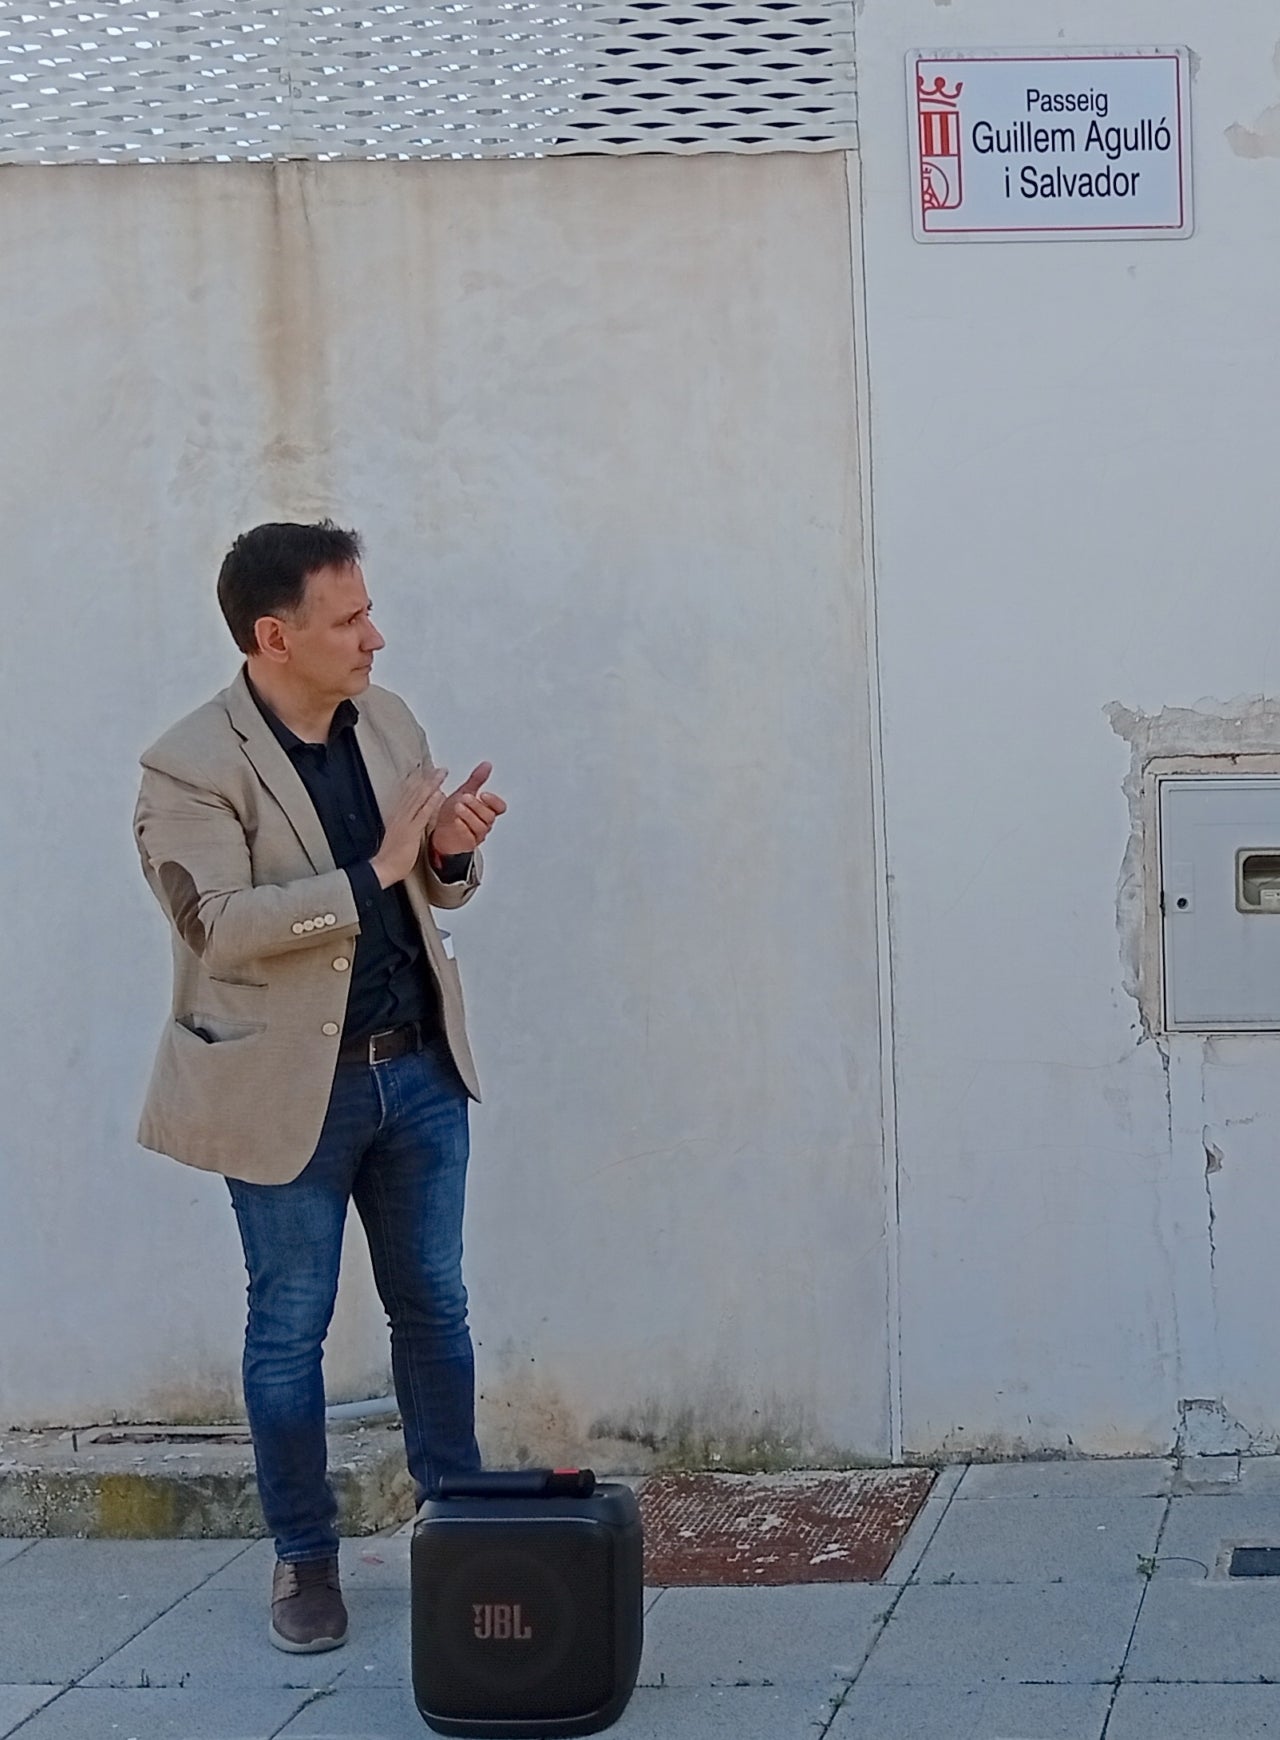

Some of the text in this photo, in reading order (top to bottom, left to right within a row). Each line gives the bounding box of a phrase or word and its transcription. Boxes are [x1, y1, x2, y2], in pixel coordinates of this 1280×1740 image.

[1026, 88, 1108, 118] Passeig
[972, 116, 1171, 160] Guillem Agulló
[1004, 165, 1140, 199] i Salvador
[473, 1604, 532, 1639] JBL
